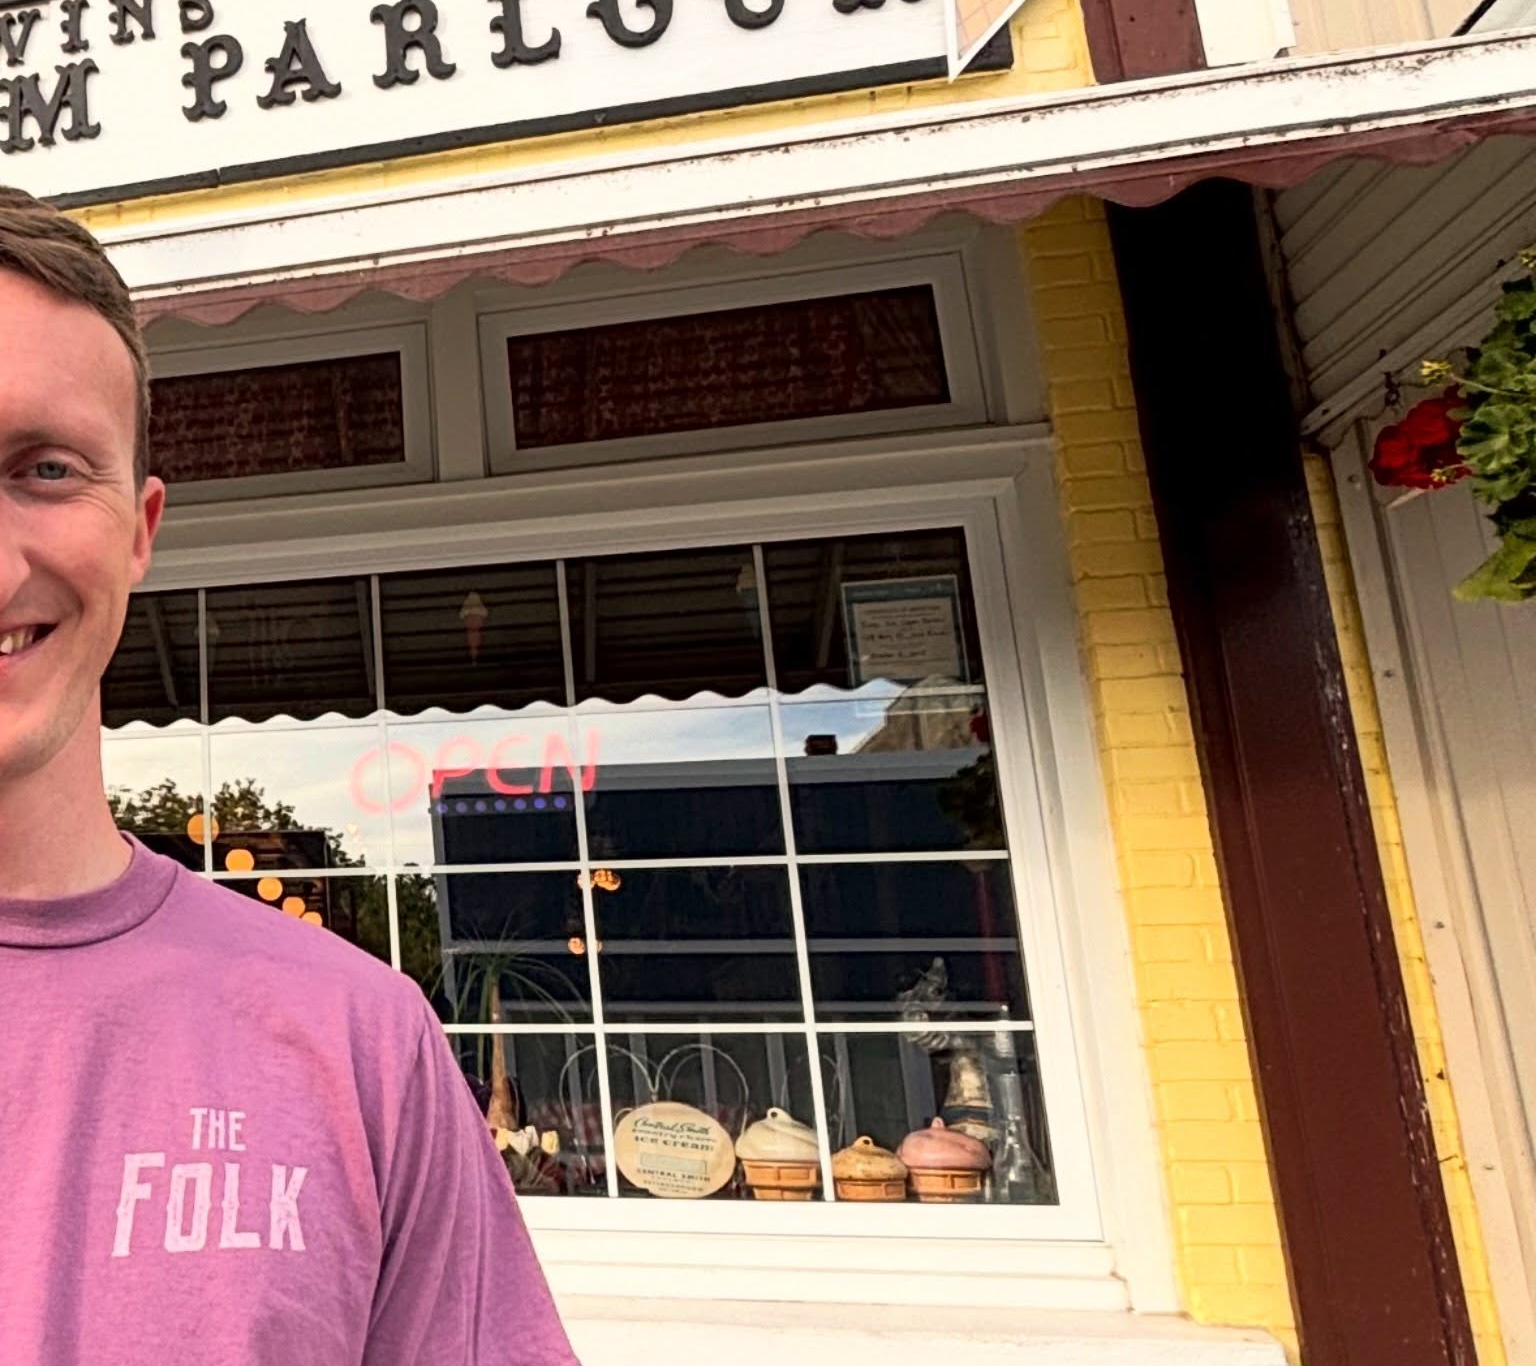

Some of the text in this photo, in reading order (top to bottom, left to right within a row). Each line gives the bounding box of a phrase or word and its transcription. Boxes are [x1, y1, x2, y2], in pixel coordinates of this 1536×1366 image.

[349, 724, 602, 815] OPEN
[189, 1107, 247, 1152] THE
[110, 1151, 309, 1258] FOLK
